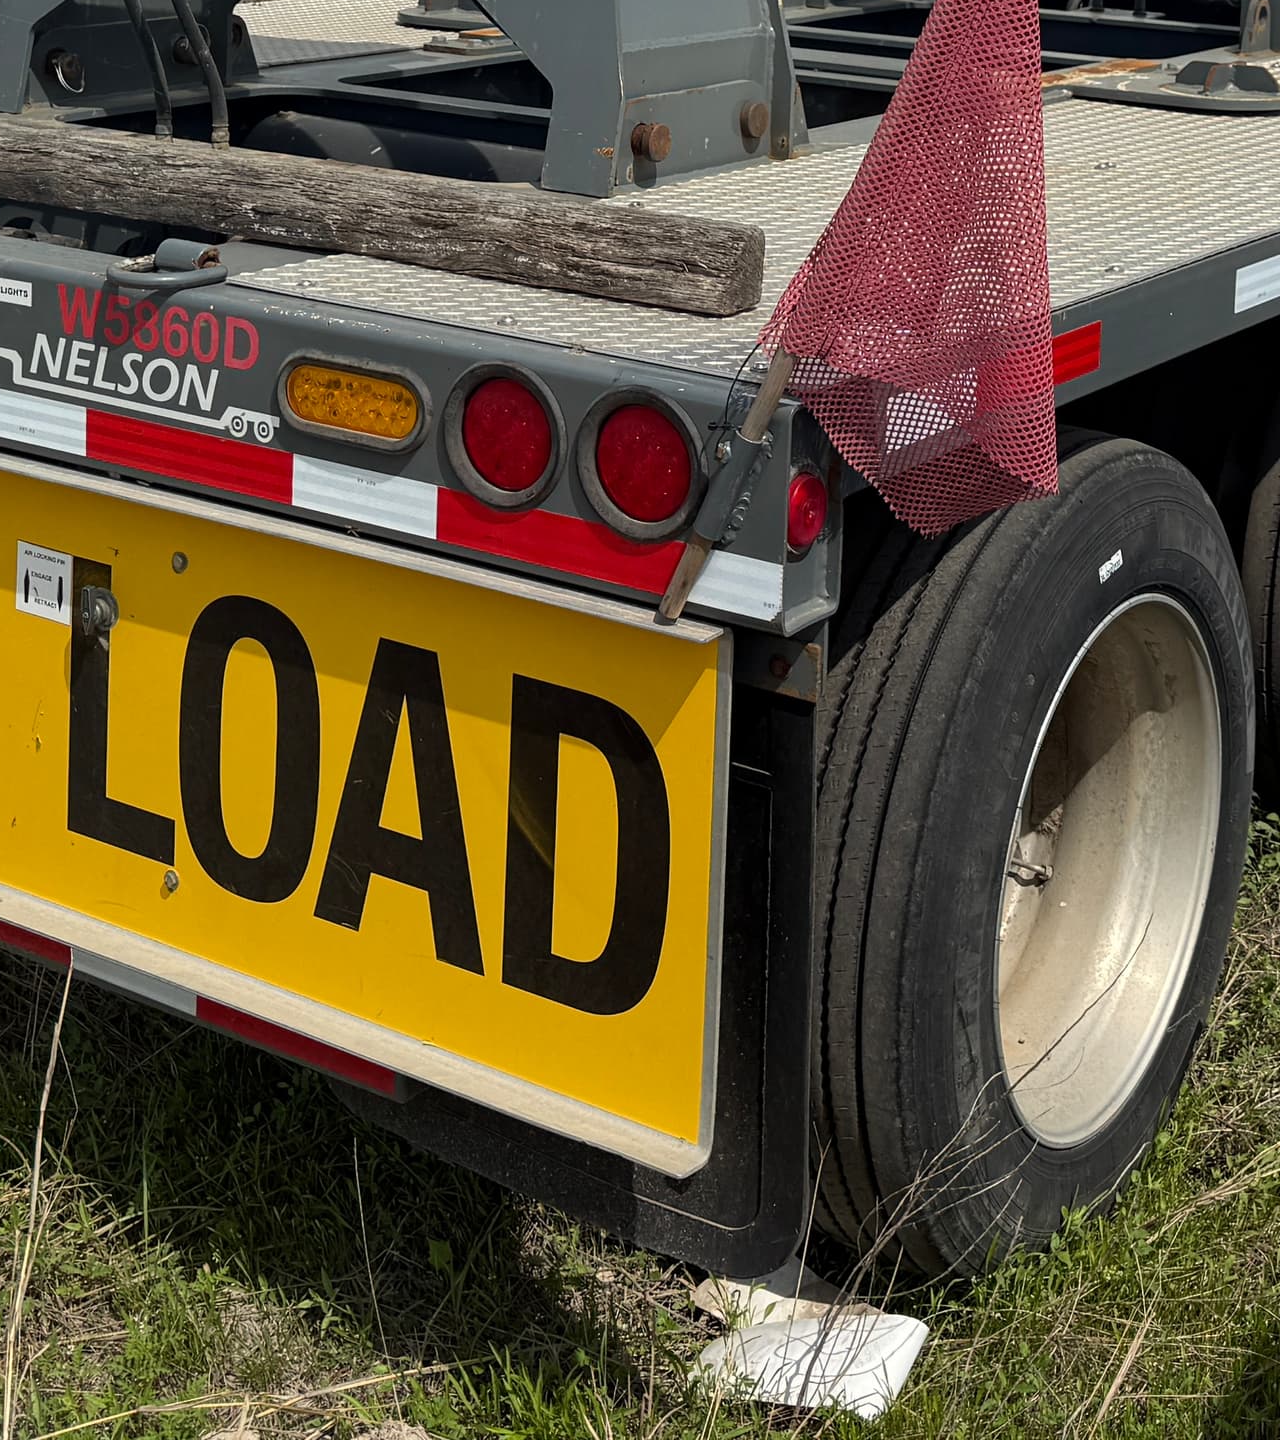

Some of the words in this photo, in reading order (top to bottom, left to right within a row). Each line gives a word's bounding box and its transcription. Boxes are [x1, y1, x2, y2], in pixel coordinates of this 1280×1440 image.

[0, 286, 28, 298] LIGHTS
[56, 283, 260, 370] W5860D
[30, 333, 219, 412] NELSON
[31, 570, 52, 582] ENGAGE
[34, 598, 57, 609] RETRACT
[67, 555, 671, 1016] LOAD
